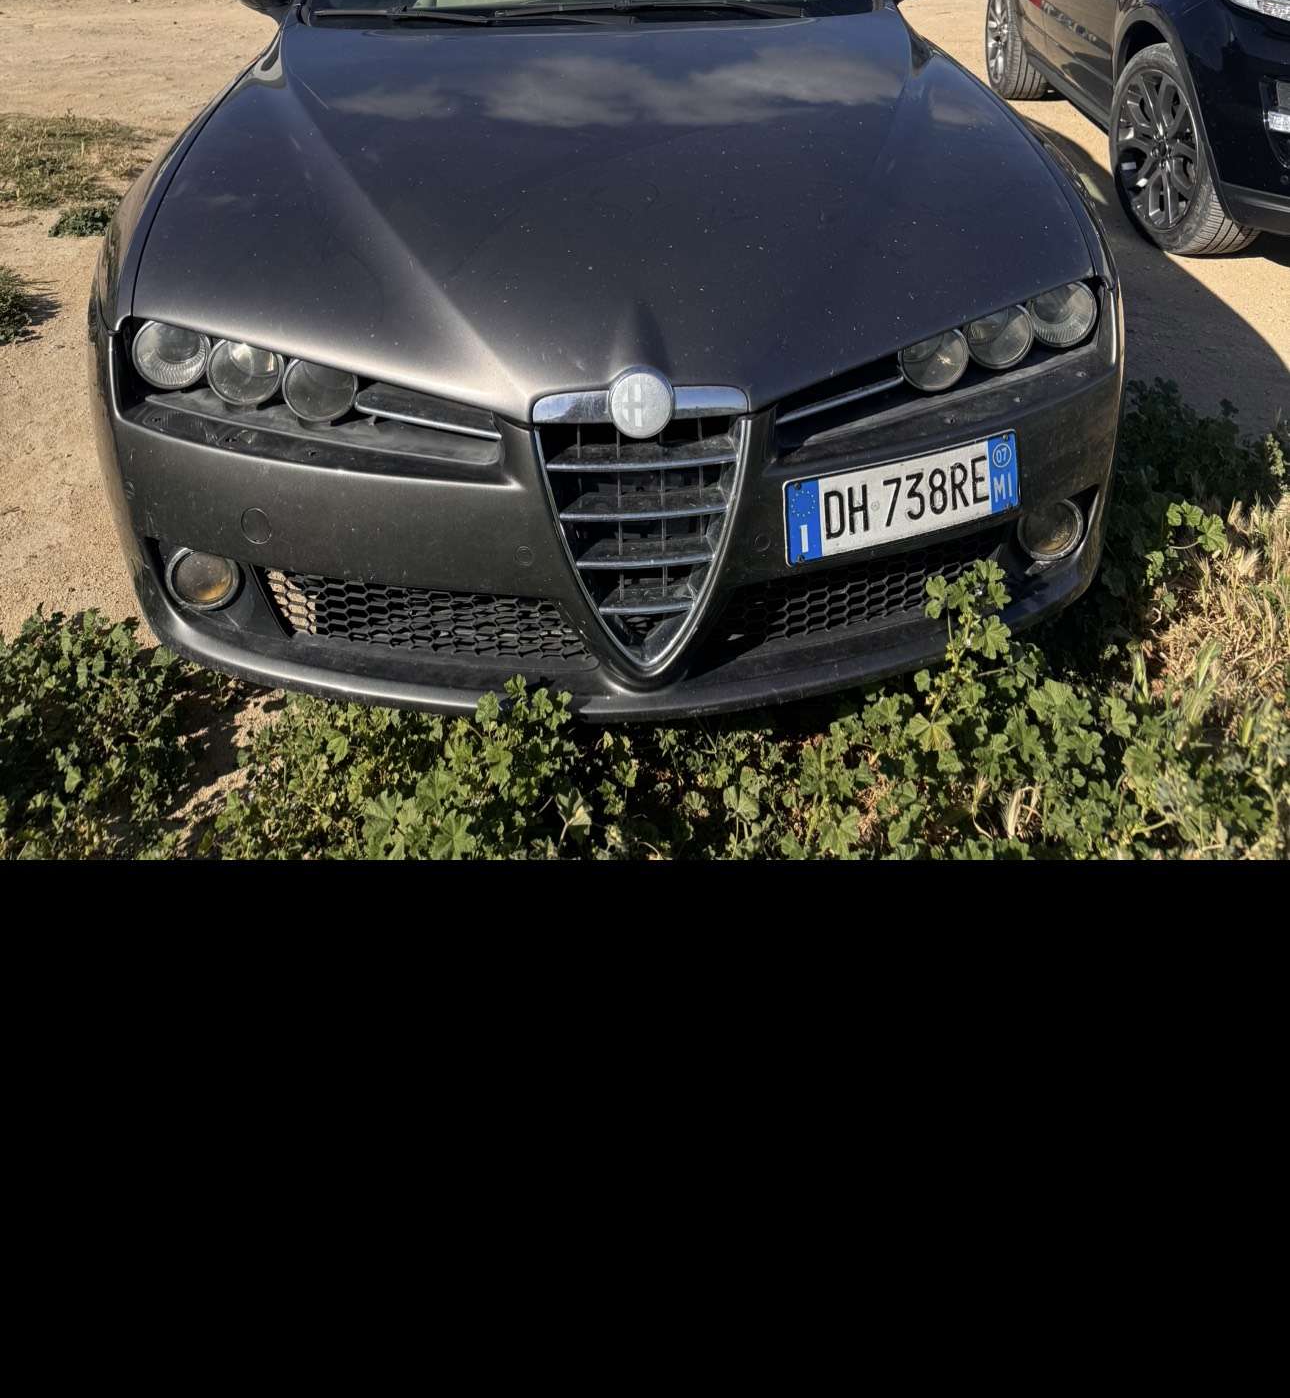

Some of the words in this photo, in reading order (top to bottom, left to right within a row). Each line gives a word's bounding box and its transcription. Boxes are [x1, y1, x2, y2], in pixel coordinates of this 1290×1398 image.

[823, 483, 870, 541] DH
[883, 455, 990, 528] 738RE
[993, 473, 1013, 502] MI
[800, 524, 809, 553] I
